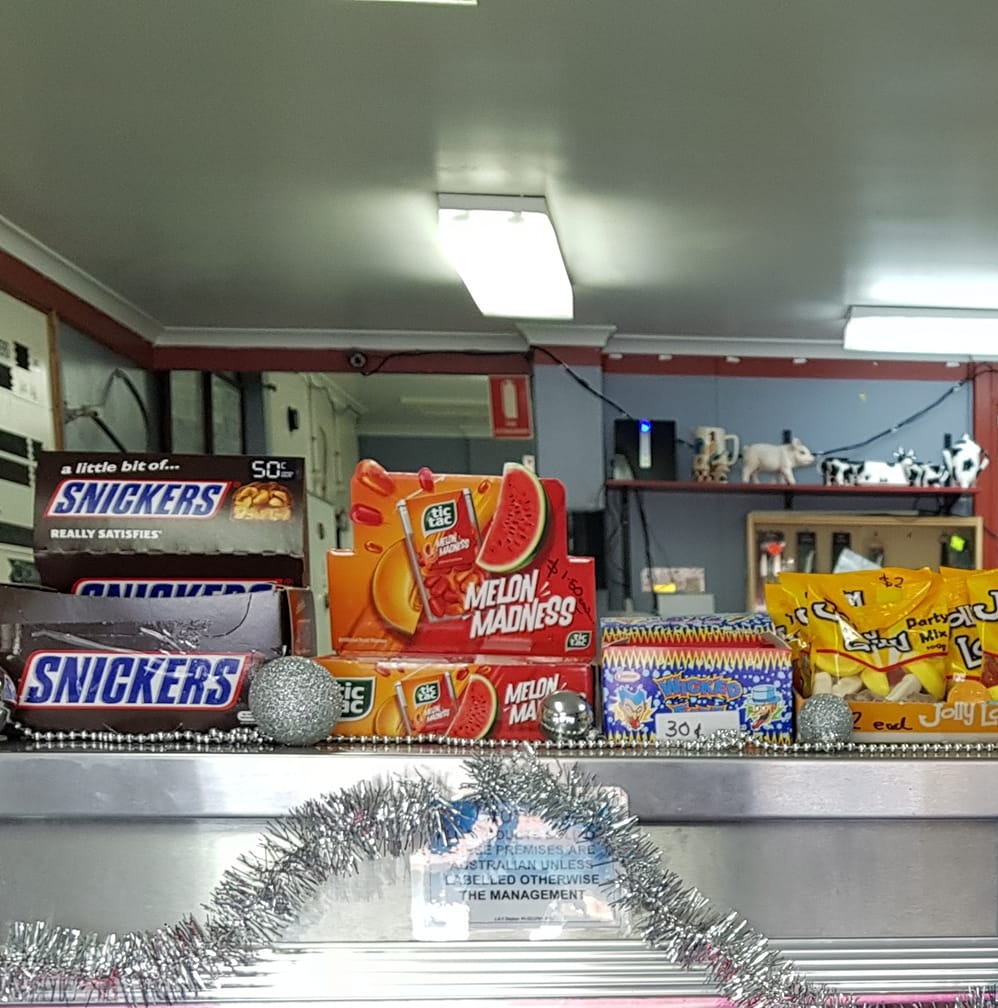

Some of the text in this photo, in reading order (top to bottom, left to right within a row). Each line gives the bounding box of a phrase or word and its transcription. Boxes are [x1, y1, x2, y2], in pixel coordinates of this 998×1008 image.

[61, 464, 72, 475] a
[76, 461, 118, 475] little
[121, 460, 147, 472] bit
[52, 481, 225, 516] SNICKERS
[431, 505, 452, 518] tic
[429, 515, 452, 528] tac
[50, 528, 97, 540] REALLY
[879, 574, 904, 589] $2
[463, 569, 539, 611] MELON
[470, 595, 577, 639] MADNESS
[906, 612, 948, 630] Party
[920, 629, 947, 644] Mix
[25, 656, 239, 706] SNICKERS
[504, 673, 559, 704] MELON
[918, 702, 976, 727] Jolly
[496, 844, 564, 856] PREMISES
[568, 844, 595, 856] ARE
[450, 859, 593, 871] AUSTRALIAN UNLESS
[445, 873, 600, 886] LABELLED OTHERWISE
[460, 889, 585, 901] THE MANAGEMENT
